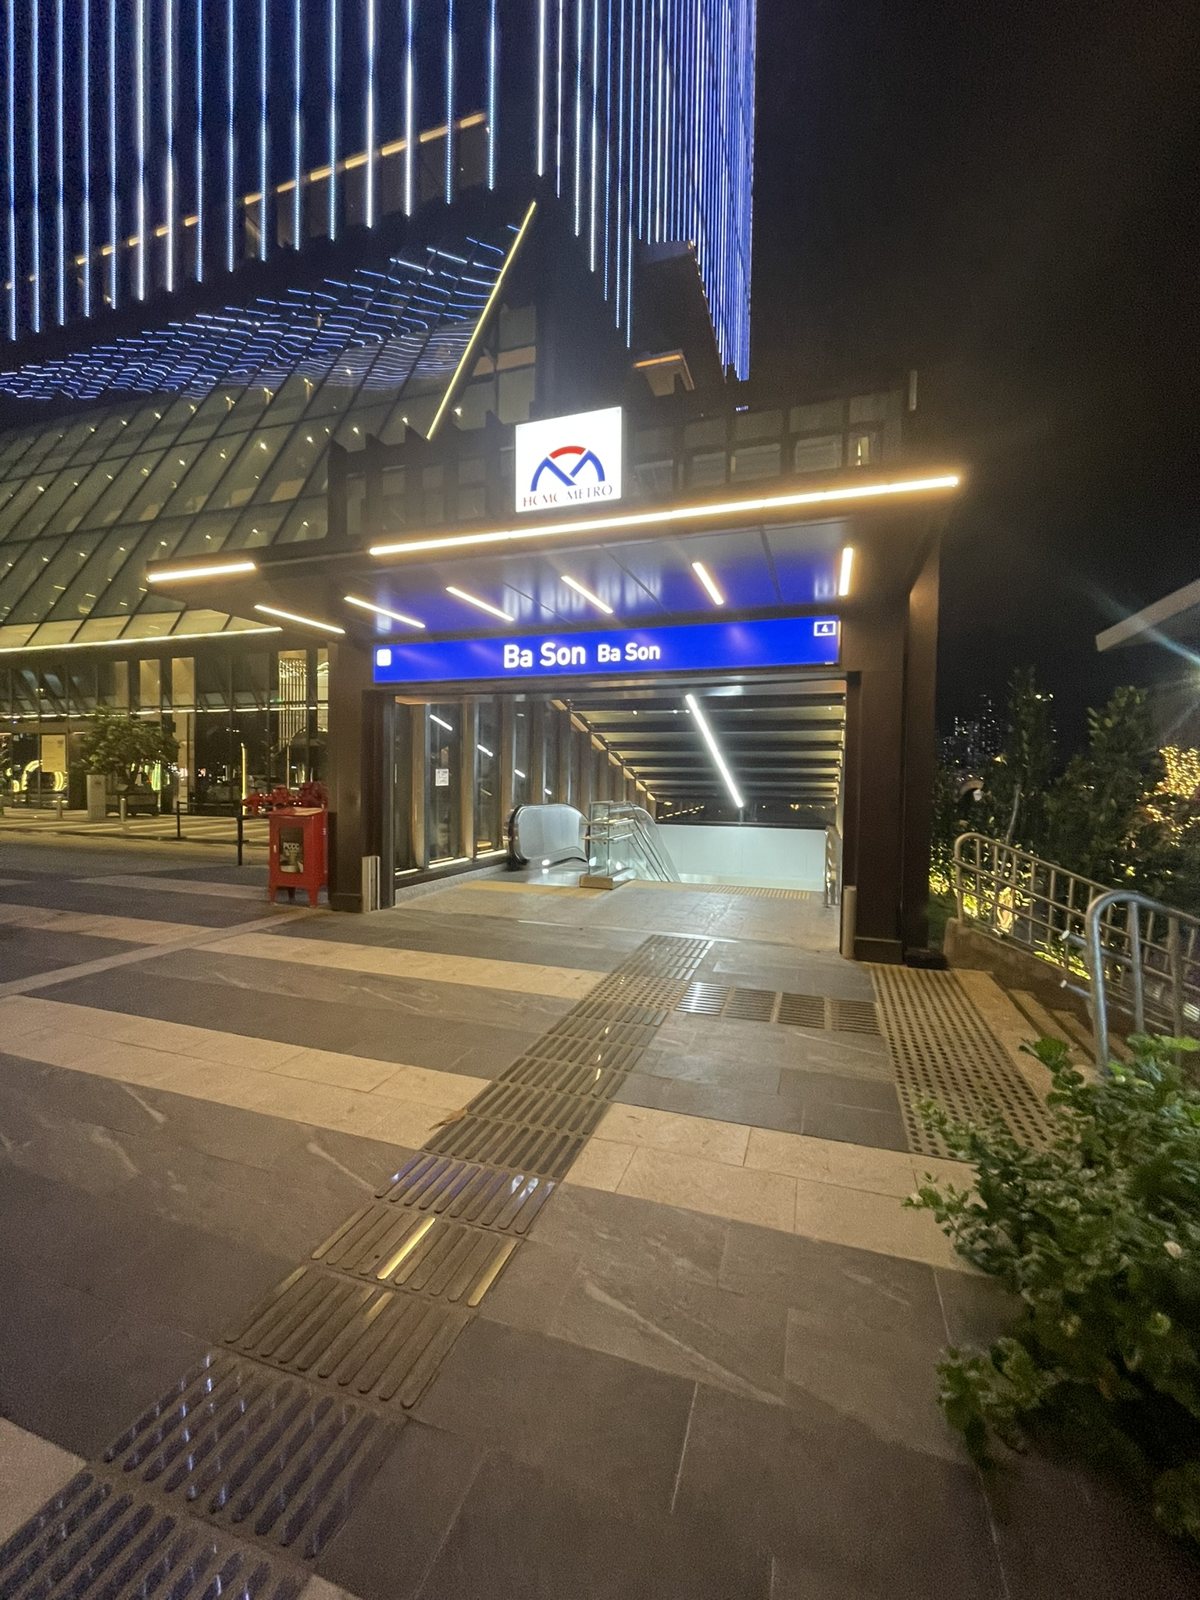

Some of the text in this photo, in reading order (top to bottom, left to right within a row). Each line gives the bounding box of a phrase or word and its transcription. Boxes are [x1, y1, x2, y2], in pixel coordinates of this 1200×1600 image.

[523, 485, 613, 507] HCMC METRO
[821, 624, 829, 633] 4
[503, 642, 661, 669] Ba Son Ba Son
